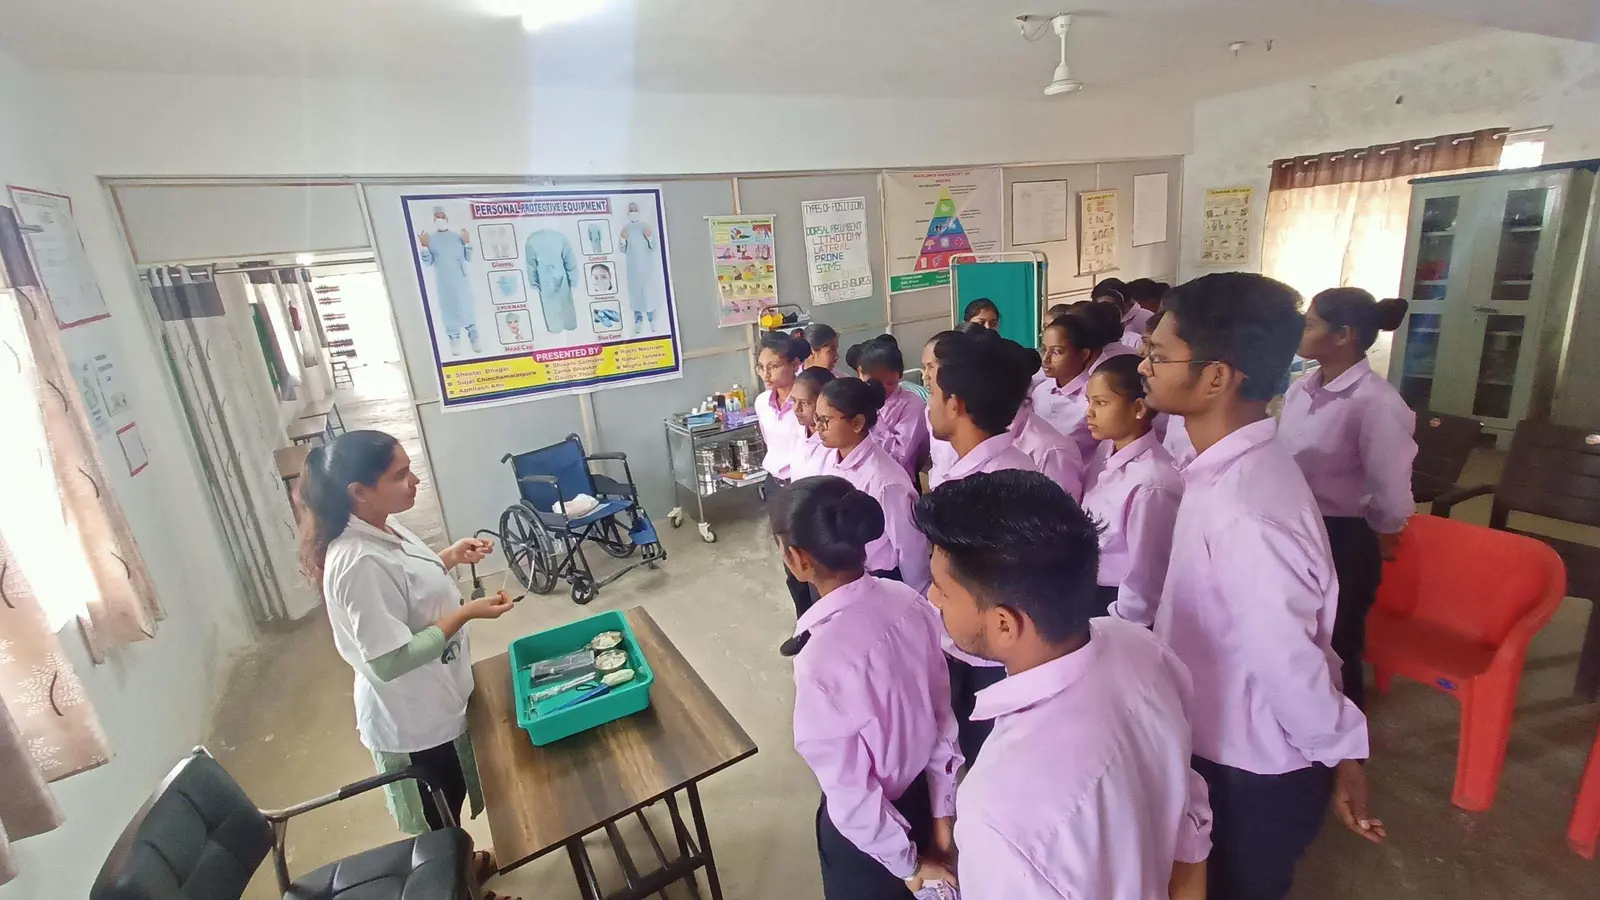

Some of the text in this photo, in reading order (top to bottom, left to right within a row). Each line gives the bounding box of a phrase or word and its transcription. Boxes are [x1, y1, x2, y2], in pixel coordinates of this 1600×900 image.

[475, 201, 606, 216] PERSONAL PROTECTIVE EQUIPMENT
[812, 231, 862, 246] LITHOTOMY
[813, 242, 851, 255] LATERAL
[814, 251, 845, 263] PRONE
[815, 261, 841, 274] SIMS
[536, 346, 600, 361] PRESENTED BY
